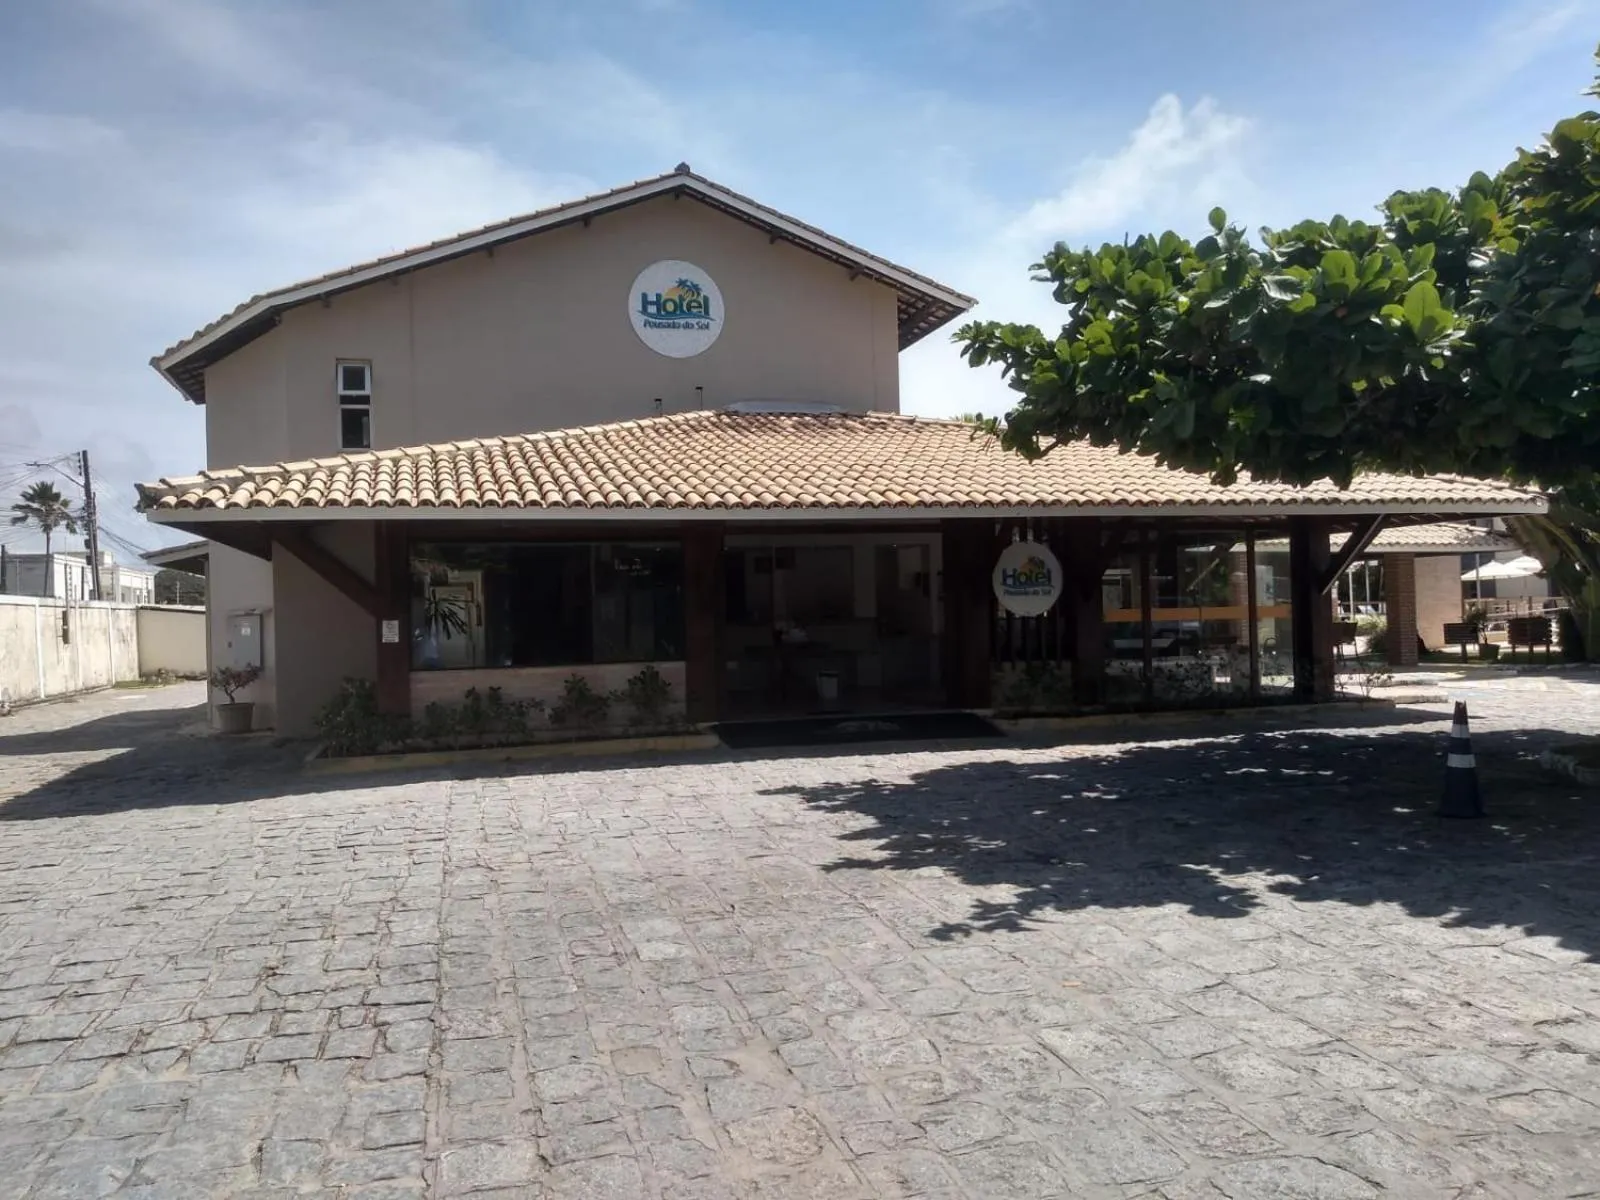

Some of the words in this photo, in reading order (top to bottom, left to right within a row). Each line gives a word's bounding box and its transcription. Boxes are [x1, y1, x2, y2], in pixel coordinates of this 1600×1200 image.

[641, 292, 710, 317] Hotel
[695, 321, 709, 331] Sol
[1002, 568, 1052, 586] Hotel
